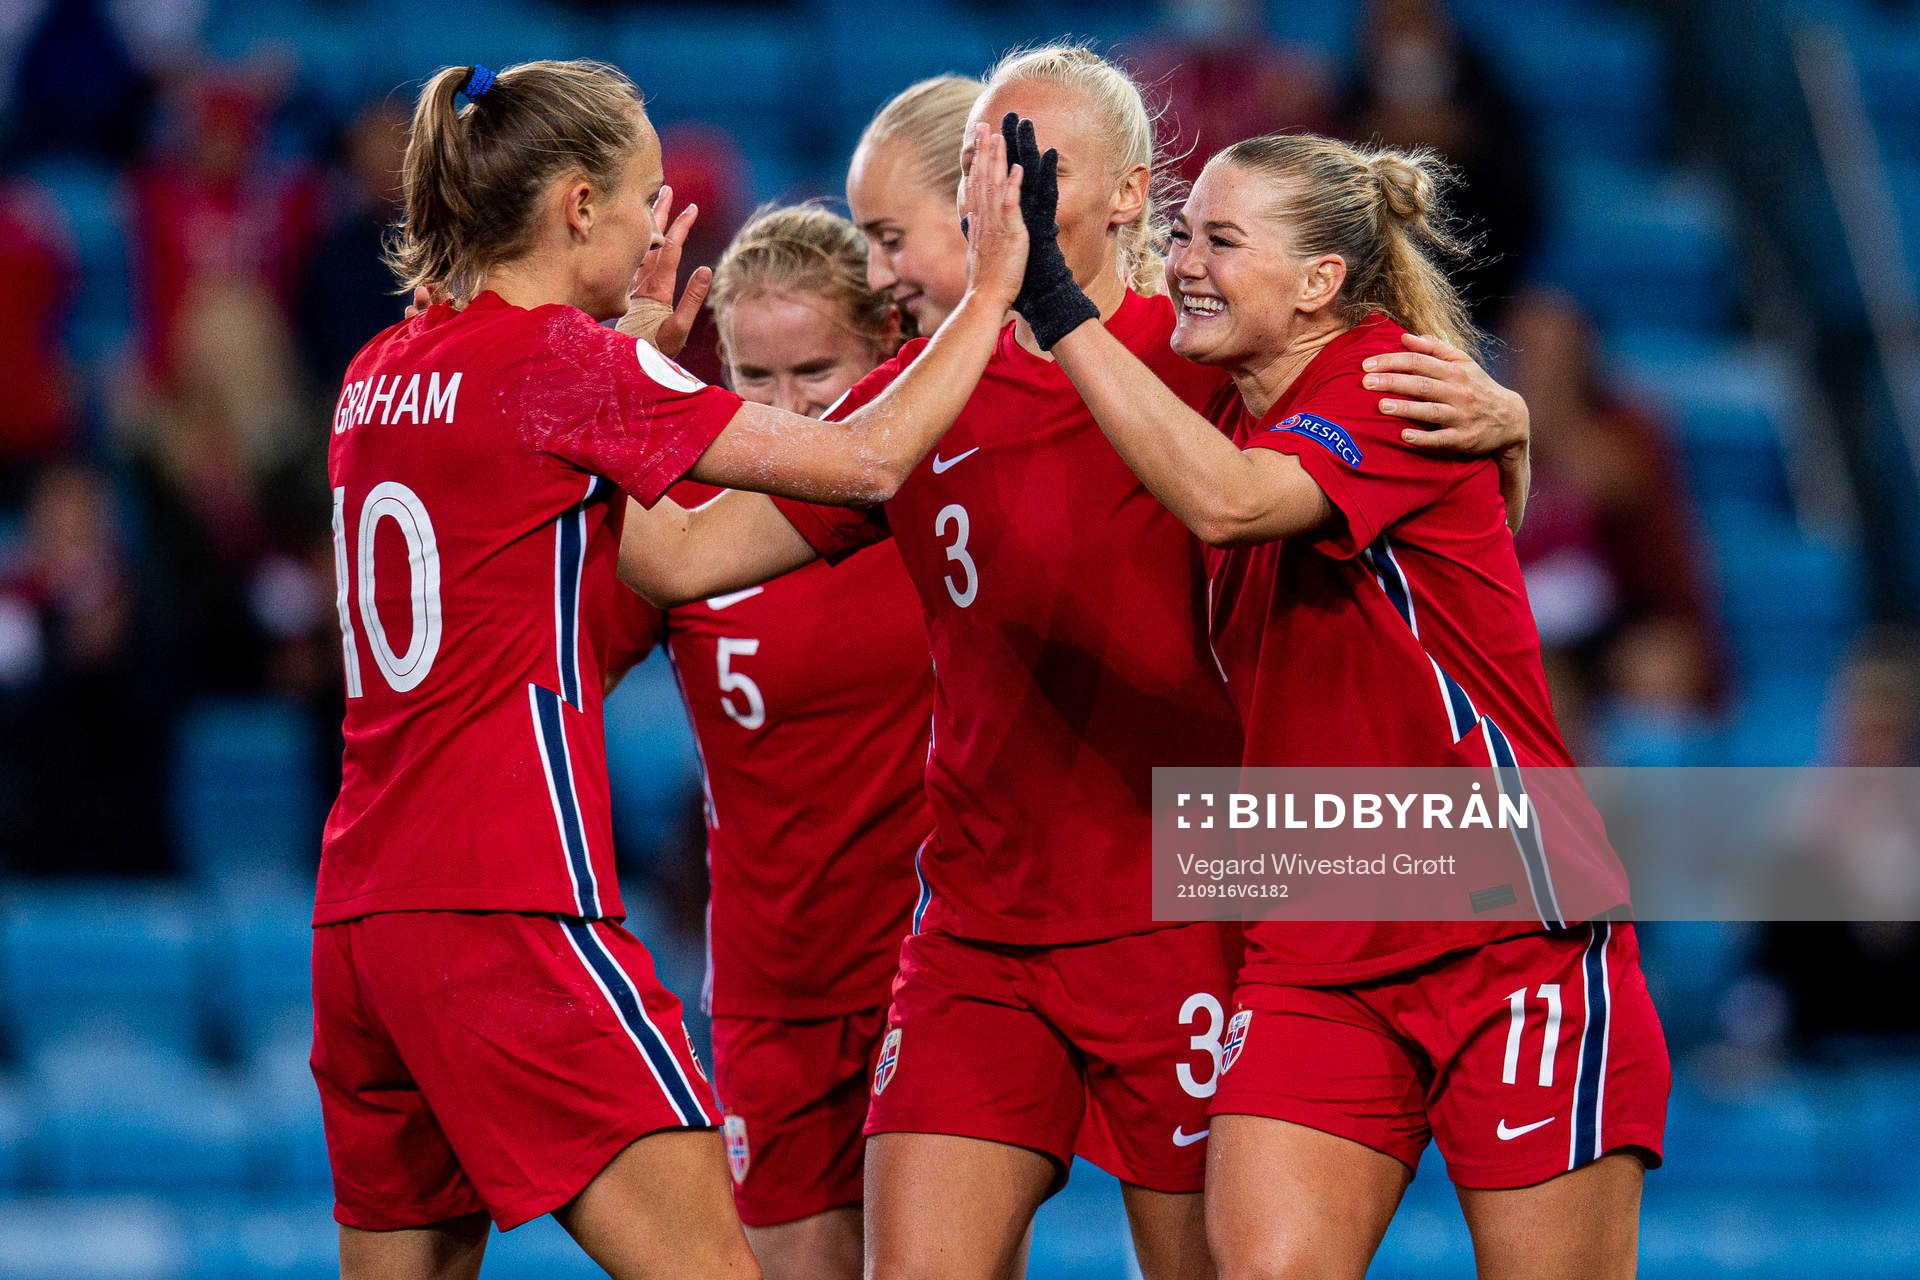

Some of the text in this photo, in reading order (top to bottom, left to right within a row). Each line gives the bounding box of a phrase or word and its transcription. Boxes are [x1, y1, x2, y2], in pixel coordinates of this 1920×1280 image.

[334, 371, 463, 435] GRAHAM
[1299, 418, 1360, 465] RESPECT
[331, 480, 443, 699] 10
[934, 503, 979, 609] 3
[716, 636, 766, 731] 5
[1175, 992, 1225, 1099] 3
[1503, 983, 1561, 1087] 11
